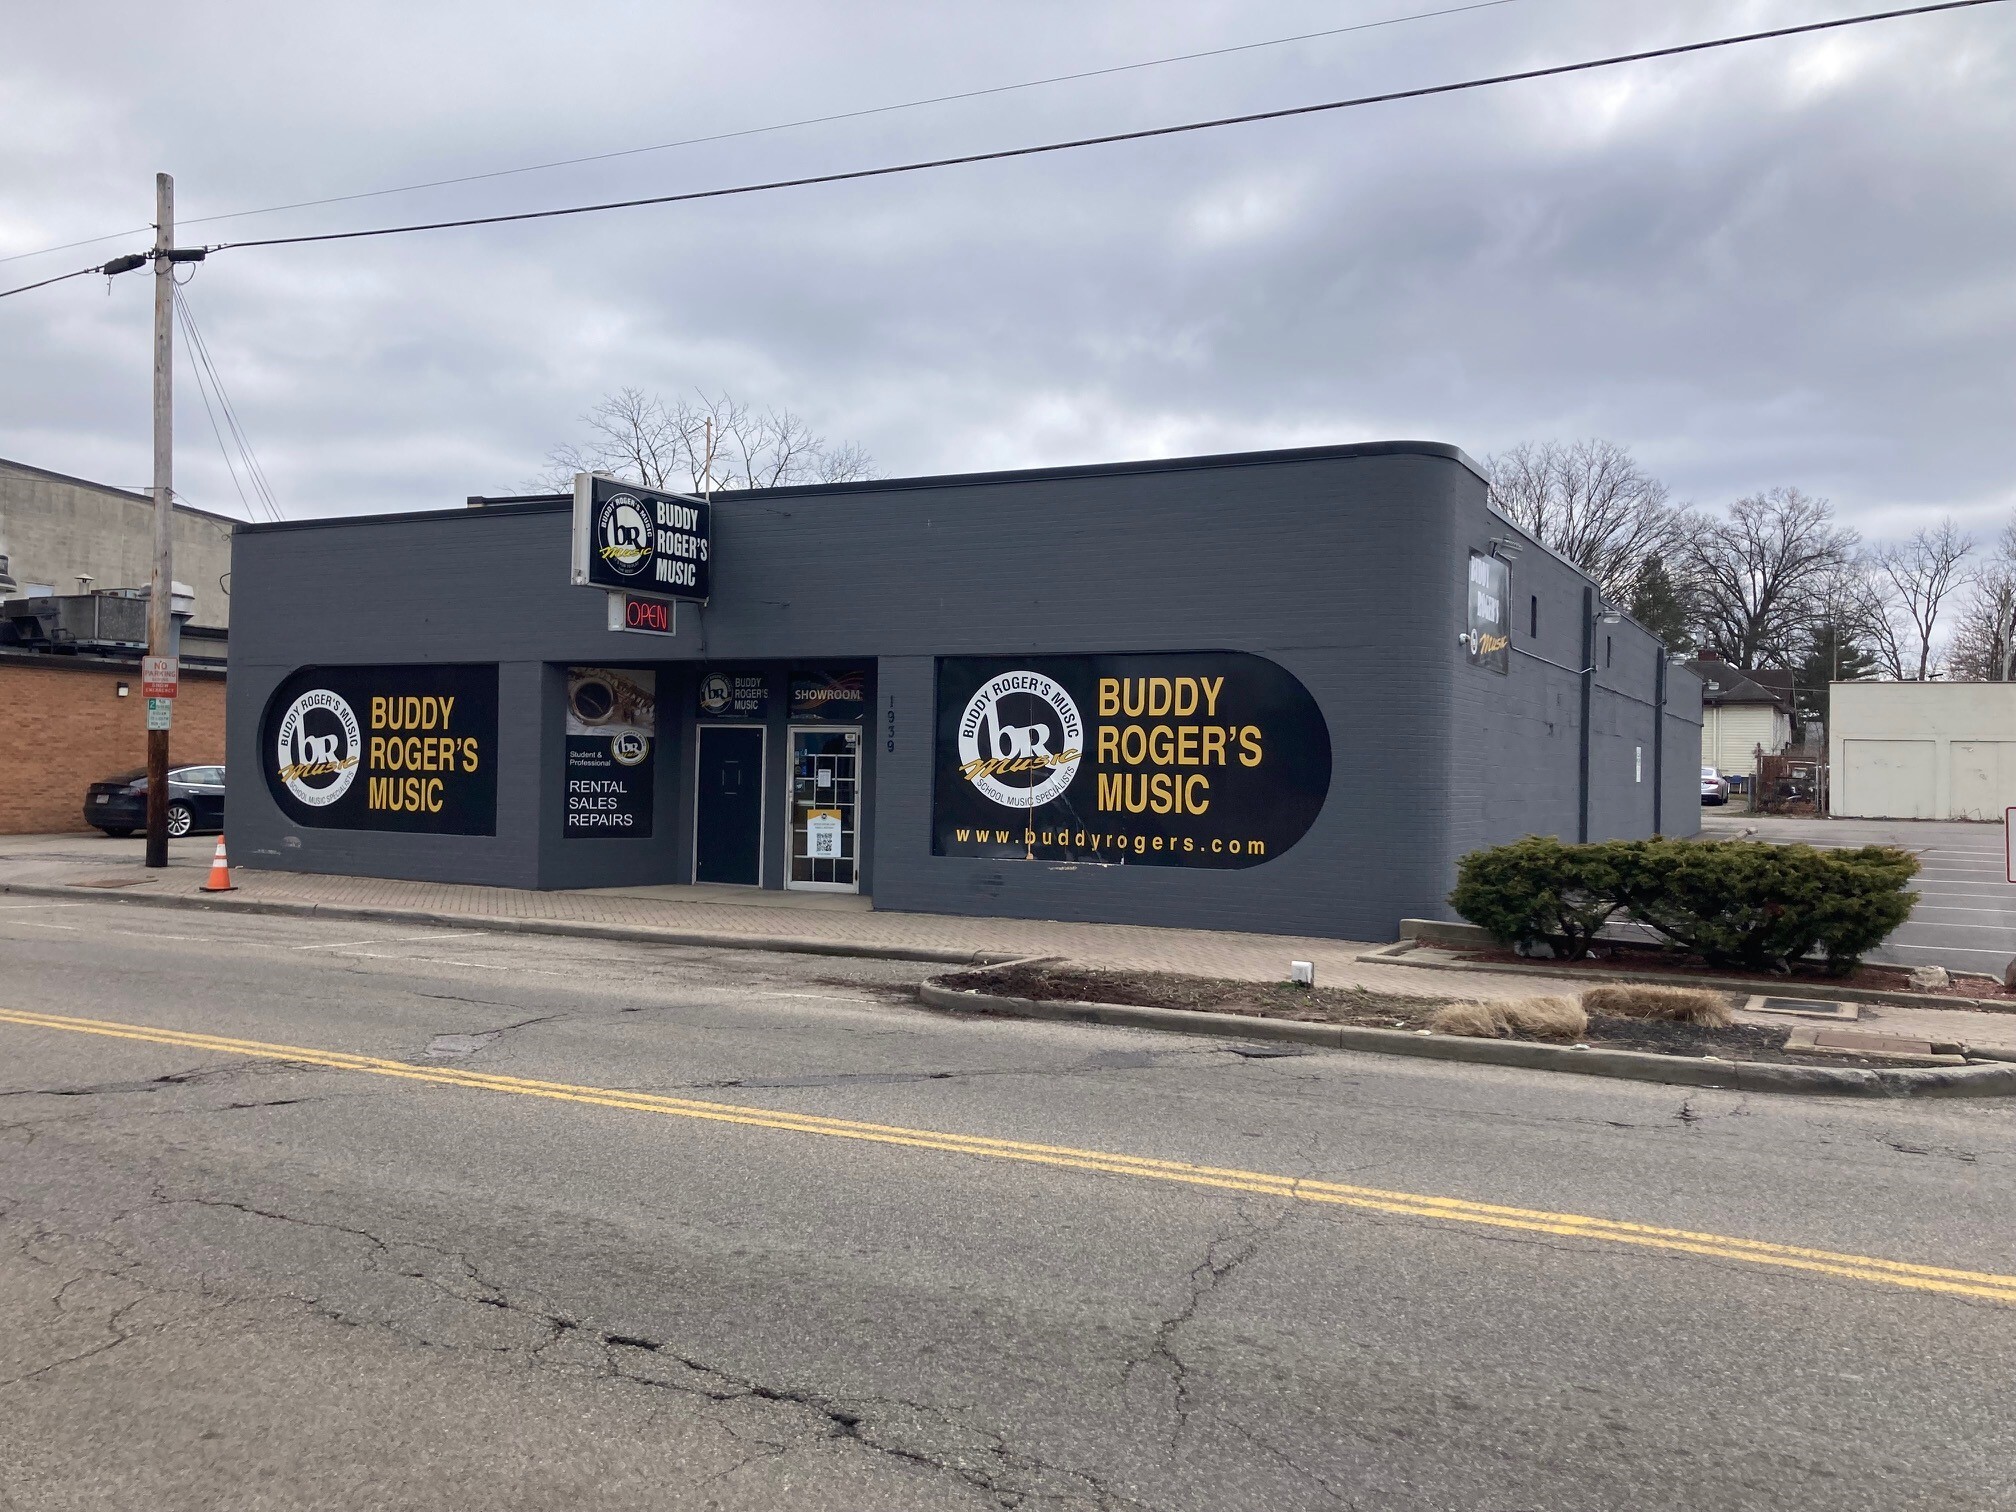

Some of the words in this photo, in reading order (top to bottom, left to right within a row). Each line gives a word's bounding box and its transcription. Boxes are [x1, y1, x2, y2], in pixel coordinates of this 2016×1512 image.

[601, 502, 616, 528] BUDDY
[615, 496, 641, 511] ROGER'S
[640, 510, 653, 538] MUSIC
[656, 502, 698, 532] BUDDY
[657, 530, 708, 562] ROGER'S
[656, 558, 696, 587] MUSIC
[628, 602, 668, 630] OPEN
[734, 688, 769, 699] ROGER'S
[735, 678, 762, 688] BUDDY
[794, 689, 860, 700] SHOWROOM
[1099, 676, 1224, 717] BUDDY
[149, 700, 156, 709] 2
[372, 696, 455, 730] BUDDY
[734, 700, 758, 710] MUSIC
[962, 690, 992, 738] BUDDY
[992, 676, 1052, 696] ROGER'S
[1050, 692, 1080, 738] MUSIC
[280, 706, 300, 746] BUDDY
[300, 694, 341, 711] ROGER'S
[340, 708, 358, 747] MUSIC
[886, 695, 896, 753] 1939
[370, 736, 479, 773] ROGER'S
[570, 750, 596, 758] Student
[1098, 724, 1263, 768] ROGER'S
[570, 759, 611, 767] Professional
[289, 781, 308, 802] SCHOOL
[308, 796, 326, 805] MUSIC
[326, 771, 354, 804] SPECIALISTS
[368, 776, 444, 813] MUSIC
[570, 780, 628, 793] RENTAL
[976, 778, 1005, 803] SCHOOL
[1006, 796, 1034, 807] MUSIC
[1035, 766, 1075, 804] SPECIALISTS
[1098, 773, 1210, 815] MUSIC
[569, 797, 618, 810] SALES
[568, 814, 634, 826] REPAIRS
[956, 828, 1266, 855] www.buddyrogers.com
